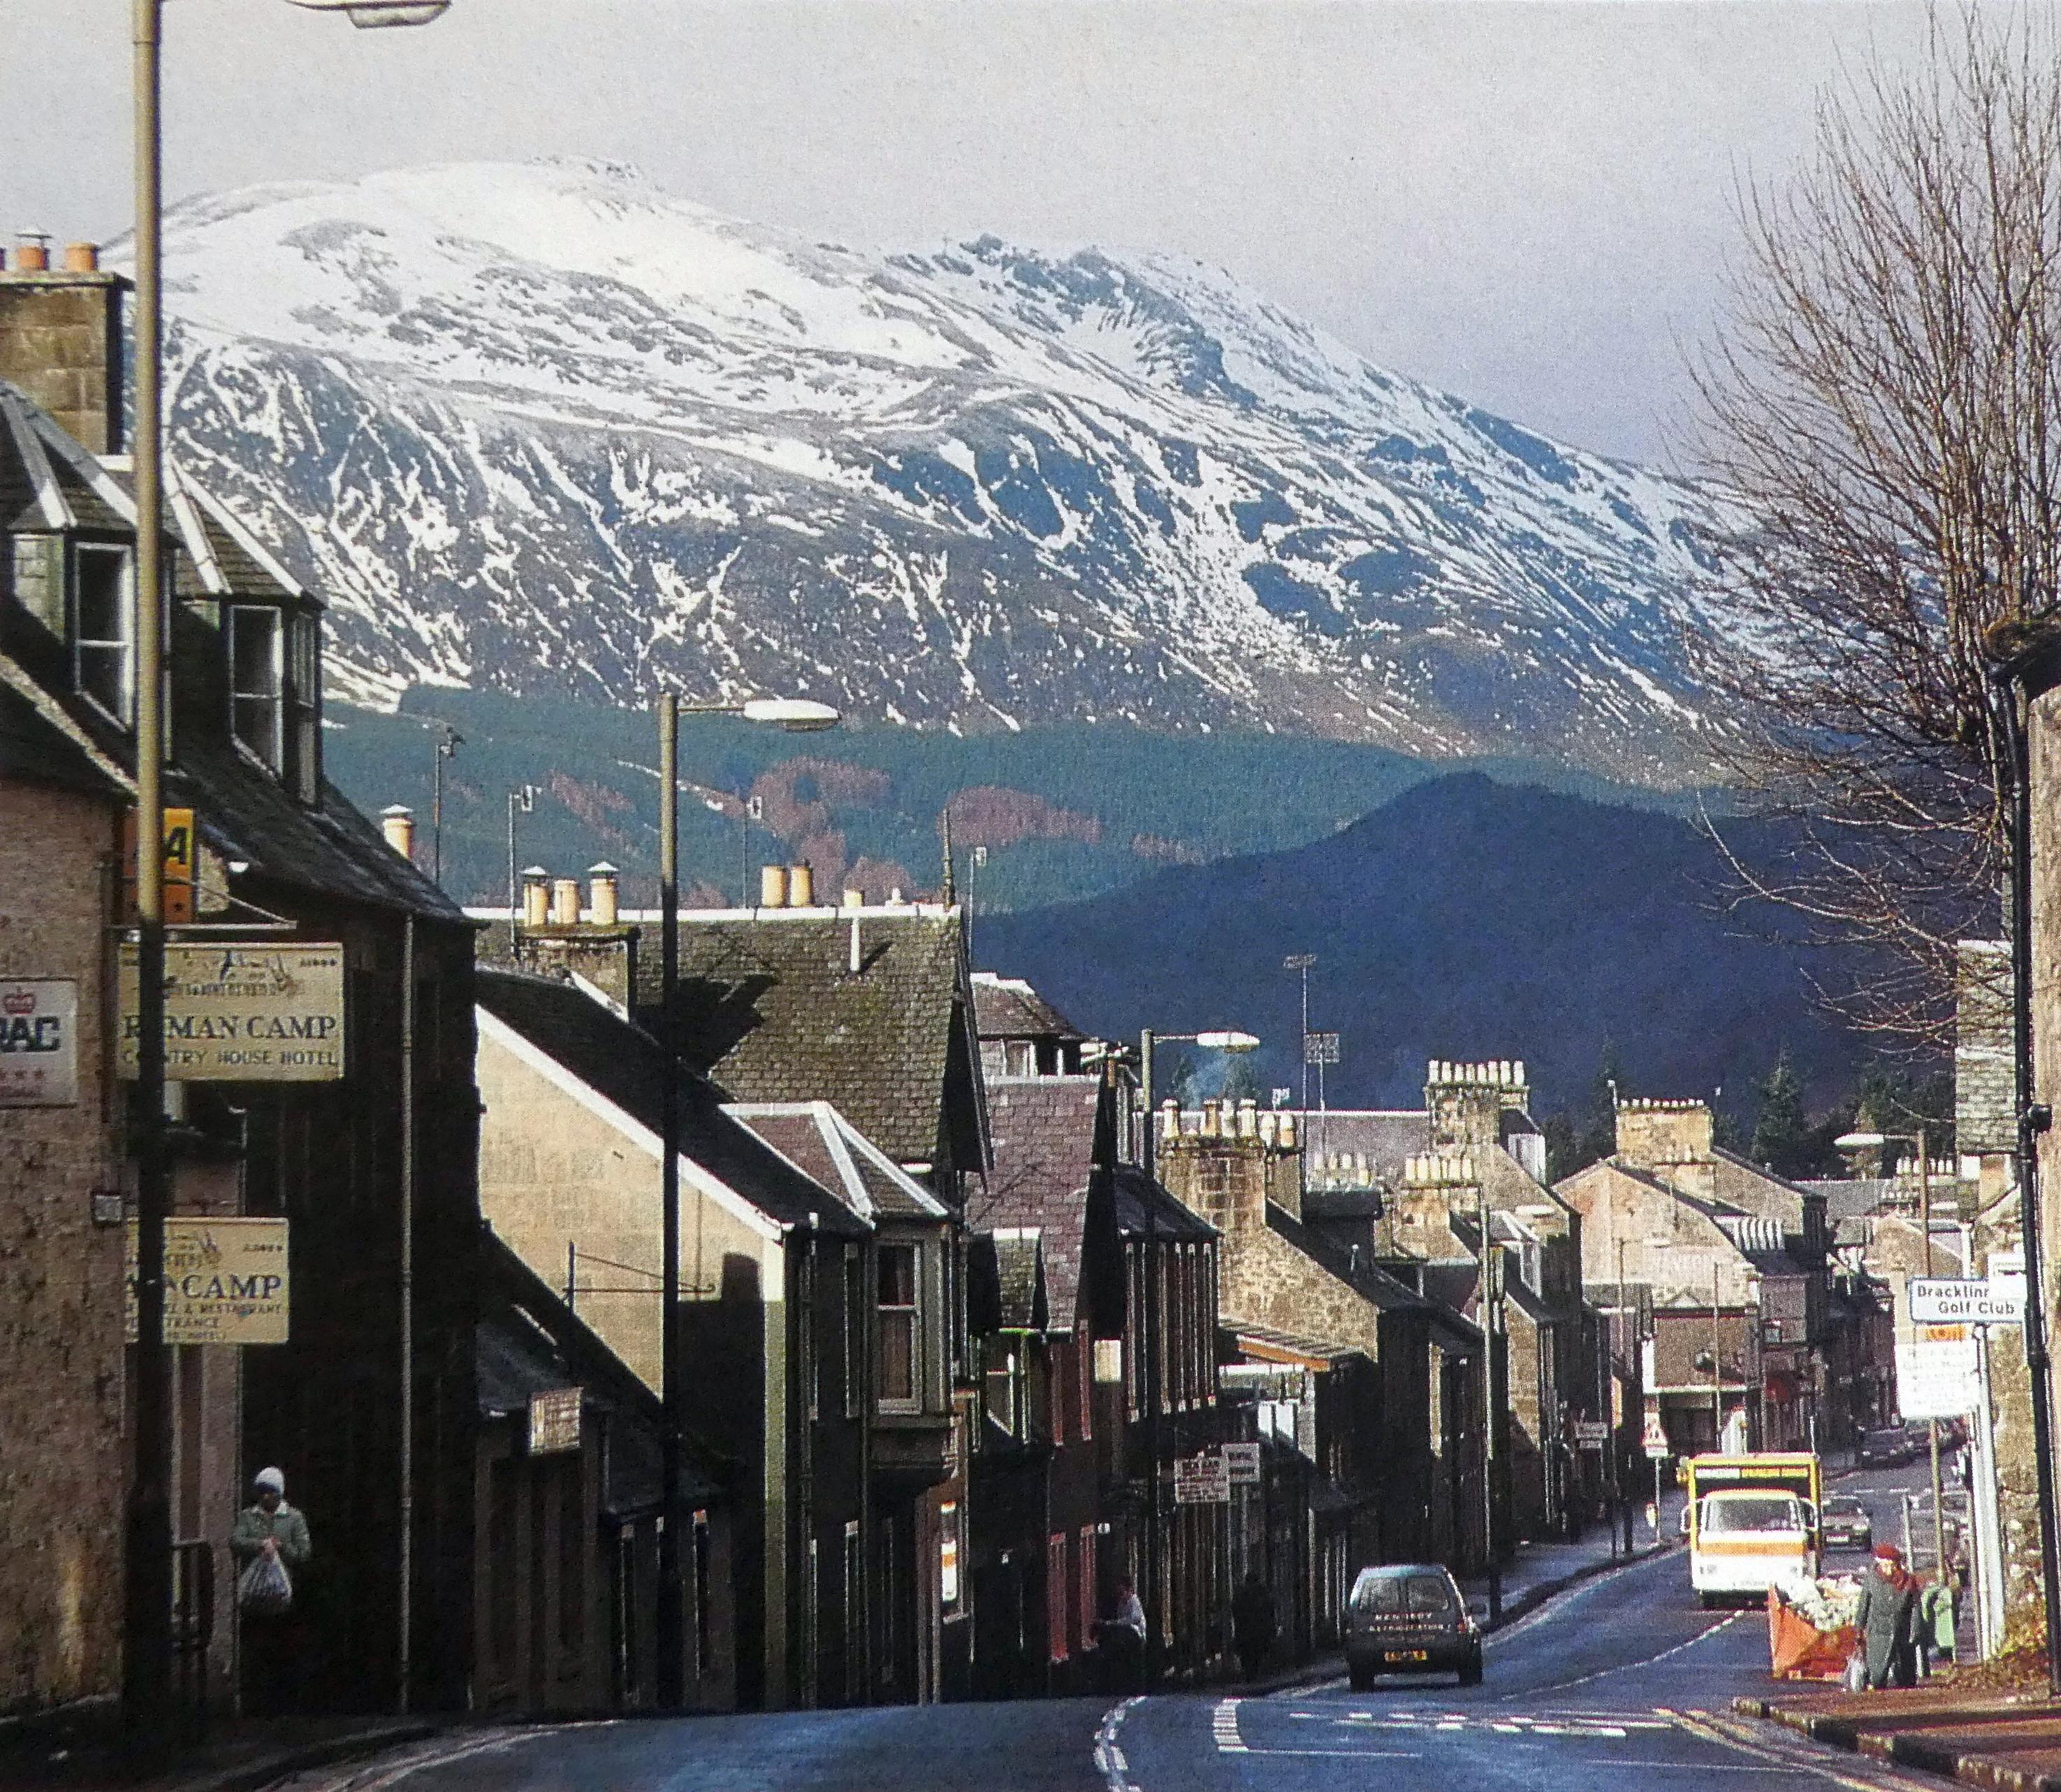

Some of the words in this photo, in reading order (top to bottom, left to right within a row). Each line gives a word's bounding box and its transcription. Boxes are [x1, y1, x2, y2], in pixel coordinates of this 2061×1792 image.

[124, 1015, 240, 1040] RMAN
[246, 1015, 337, 1040] CAMP
[123, 1049, 207, 1065] CTRY
[218, 1050, 272, 1065] HOUSE
[280, 1050, 340, 1066] HOTEL
[182, 1274, 282, 1299] CAMP
[1937, 1301, 1971, 1315] Golf
[1977, 1300, 2016, 1315] Club
